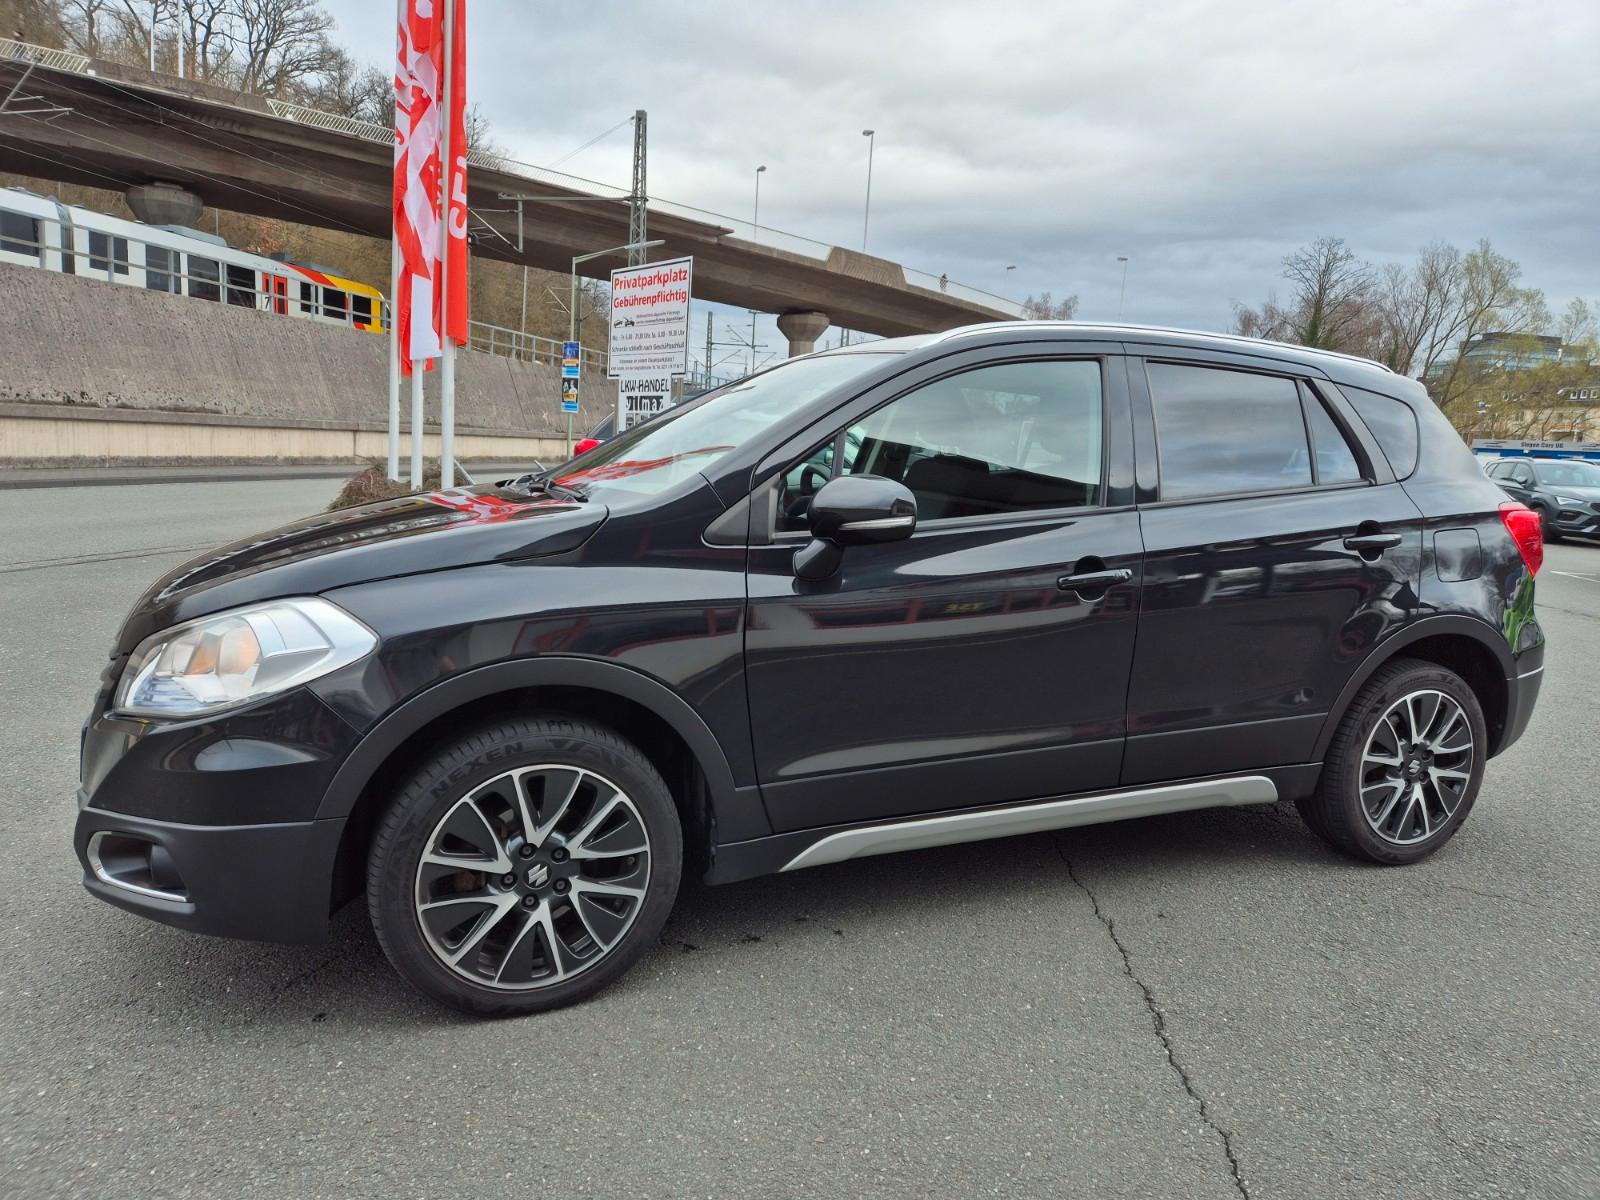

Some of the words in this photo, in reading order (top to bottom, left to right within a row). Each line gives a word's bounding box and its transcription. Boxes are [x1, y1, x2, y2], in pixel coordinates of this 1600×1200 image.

[614, 268, 688, 290] Privatparkplatz
[613, 288, 687, 308] Gebührenpflichtig
[620, 378, 670, 392] LKW-HANDEL
[429, 741, 524, 799] NEXEN
